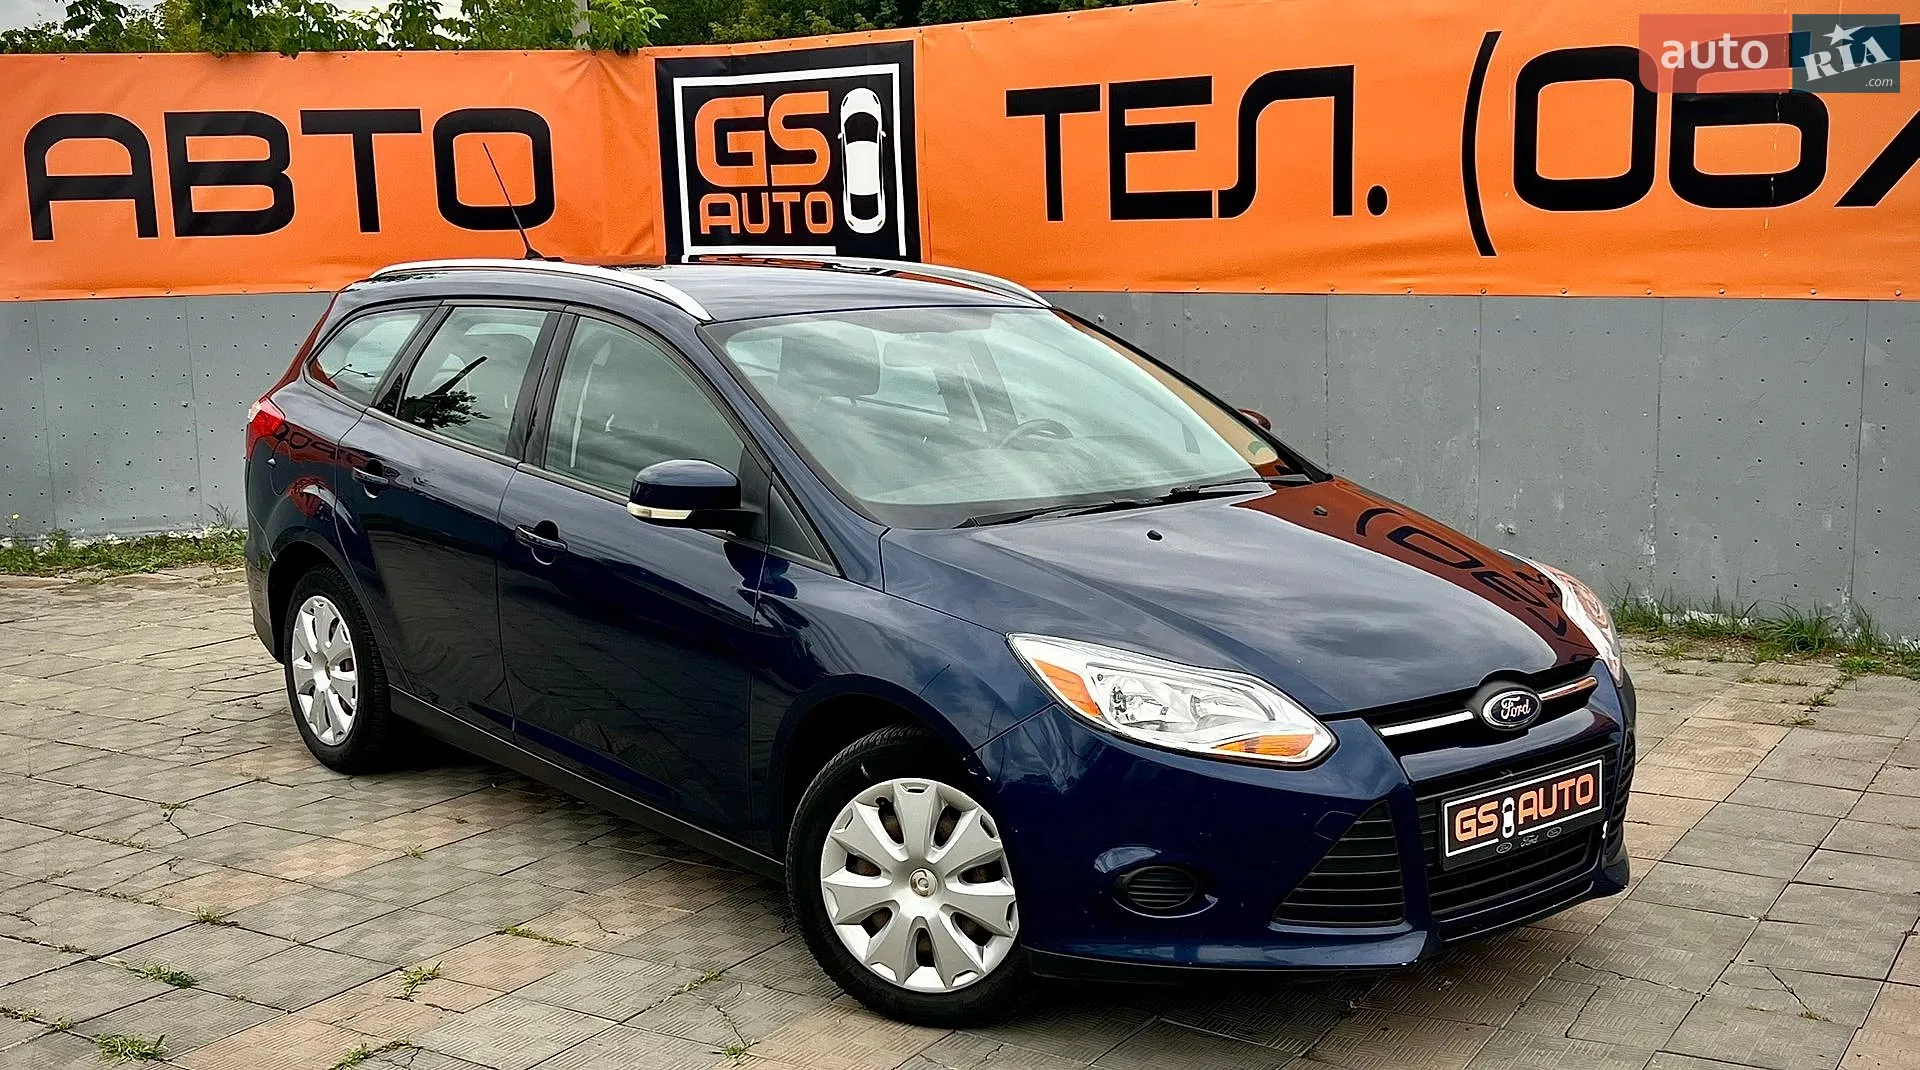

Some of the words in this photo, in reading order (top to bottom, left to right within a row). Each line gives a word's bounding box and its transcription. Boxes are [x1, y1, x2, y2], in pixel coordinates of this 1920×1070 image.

[23, 107, 557, 241] АВТО
[694, 90, 830, 187] GS
[1005, 64, 1389, 222] ТЕЛ.
[699, 191, 834, 234] AUTO
[1501, 697, 1531, 720] Ford
[1455, 801, 1498, 841] GS
[1518, 773, 1593, 825] AUTO
